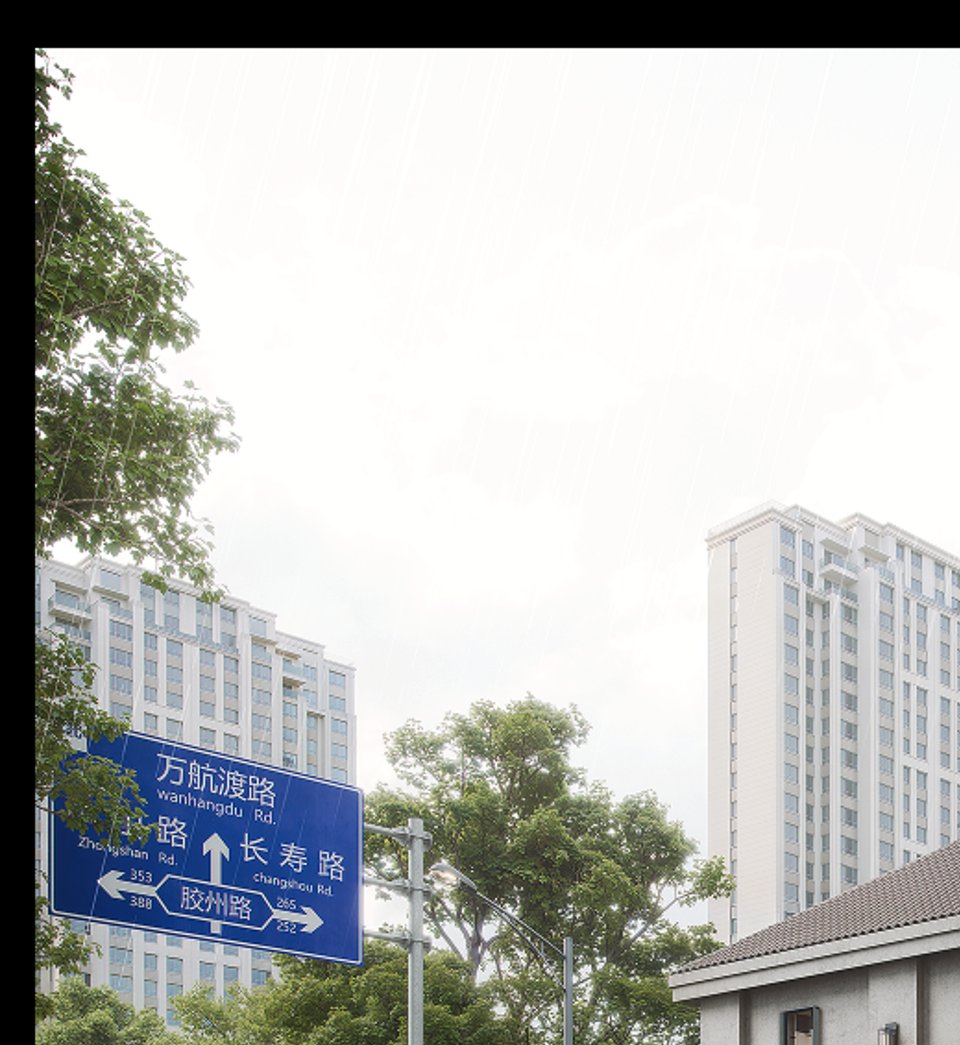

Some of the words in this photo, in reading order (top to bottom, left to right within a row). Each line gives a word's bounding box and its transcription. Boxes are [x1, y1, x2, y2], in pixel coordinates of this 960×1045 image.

[156, 753, 276, 808] 万航渡路
[156, 788, 243, 817] wanhangdu
[254, 809, 276, 825] Rd.
[158, 851, 178, 866] Rd.
[130, 868, 153, 884] 353
[180, 886, 252, 921] 胶州路
[276, 897, 297, 910] 265
[276, 919, 297, 935] 252
